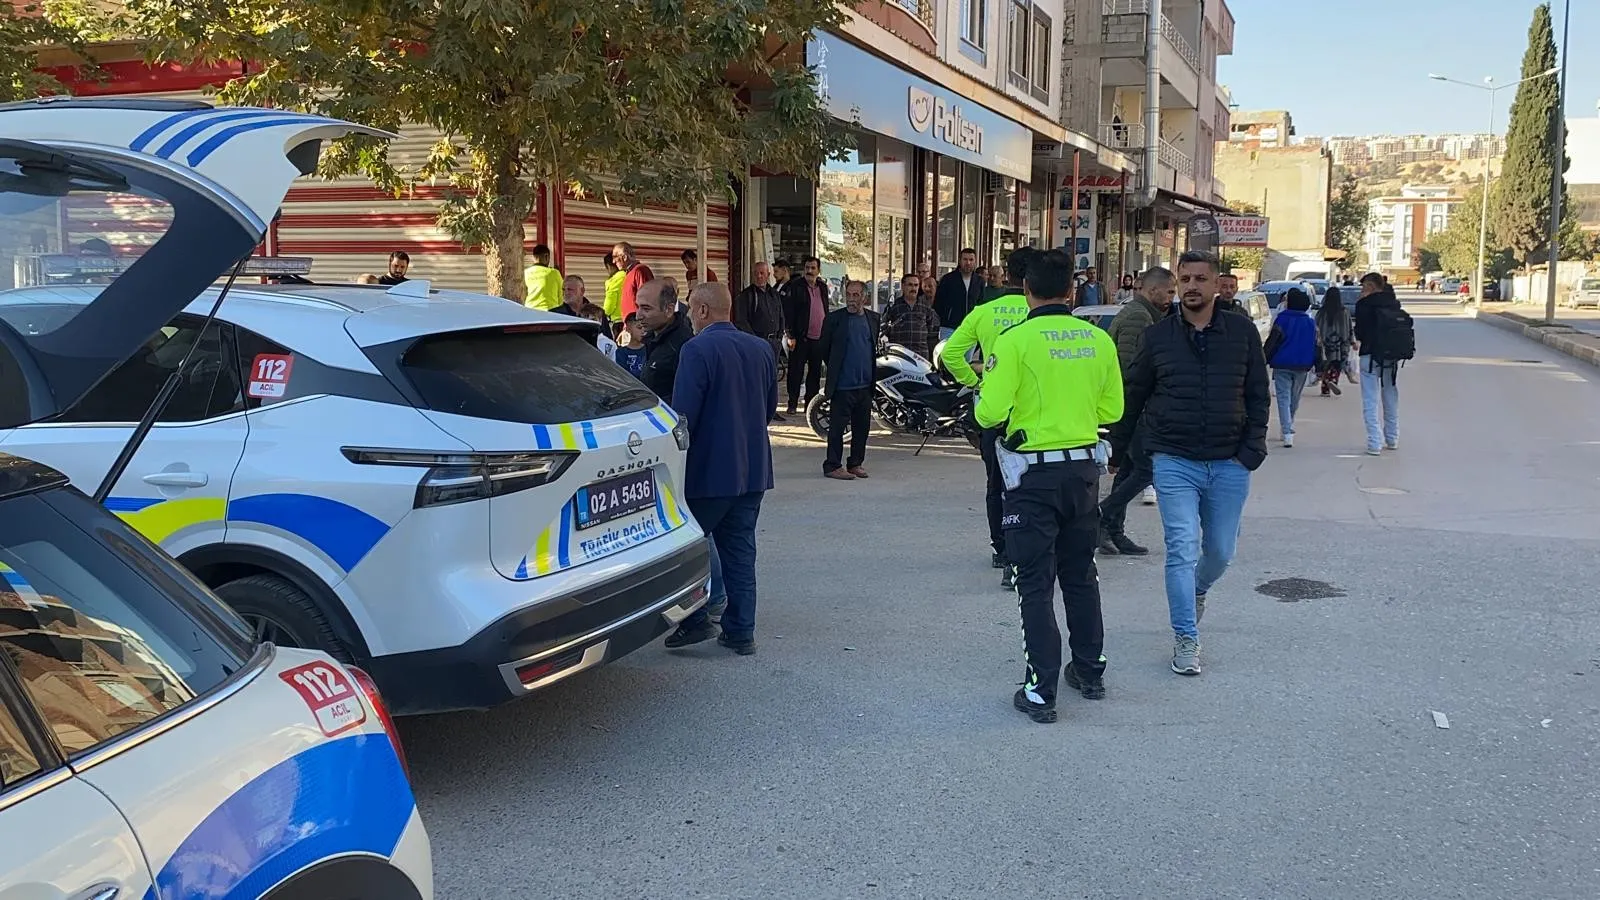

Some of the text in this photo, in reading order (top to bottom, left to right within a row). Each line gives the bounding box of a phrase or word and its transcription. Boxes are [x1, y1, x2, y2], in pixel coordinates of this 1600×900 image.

[934, 96, 985, 155] Polisan
[1223, 226, 1259, 234] SALONU
[1237, 219, 1266, 227] KEBAP
[992, 306, 1029, 315] TRAFI
[257, 358, 287, 380] 112
[597, 455, 660, 479] QASHQAI
[590, 492, 607, 515] 02
[610, 489, 620, 508] A
[622, 480, 651, 504] 5436
[580, 518, 601, 530] NISSAN
[1001, 514, 1021, 526] RAFIK
[293, 666, 348, 702] 112
